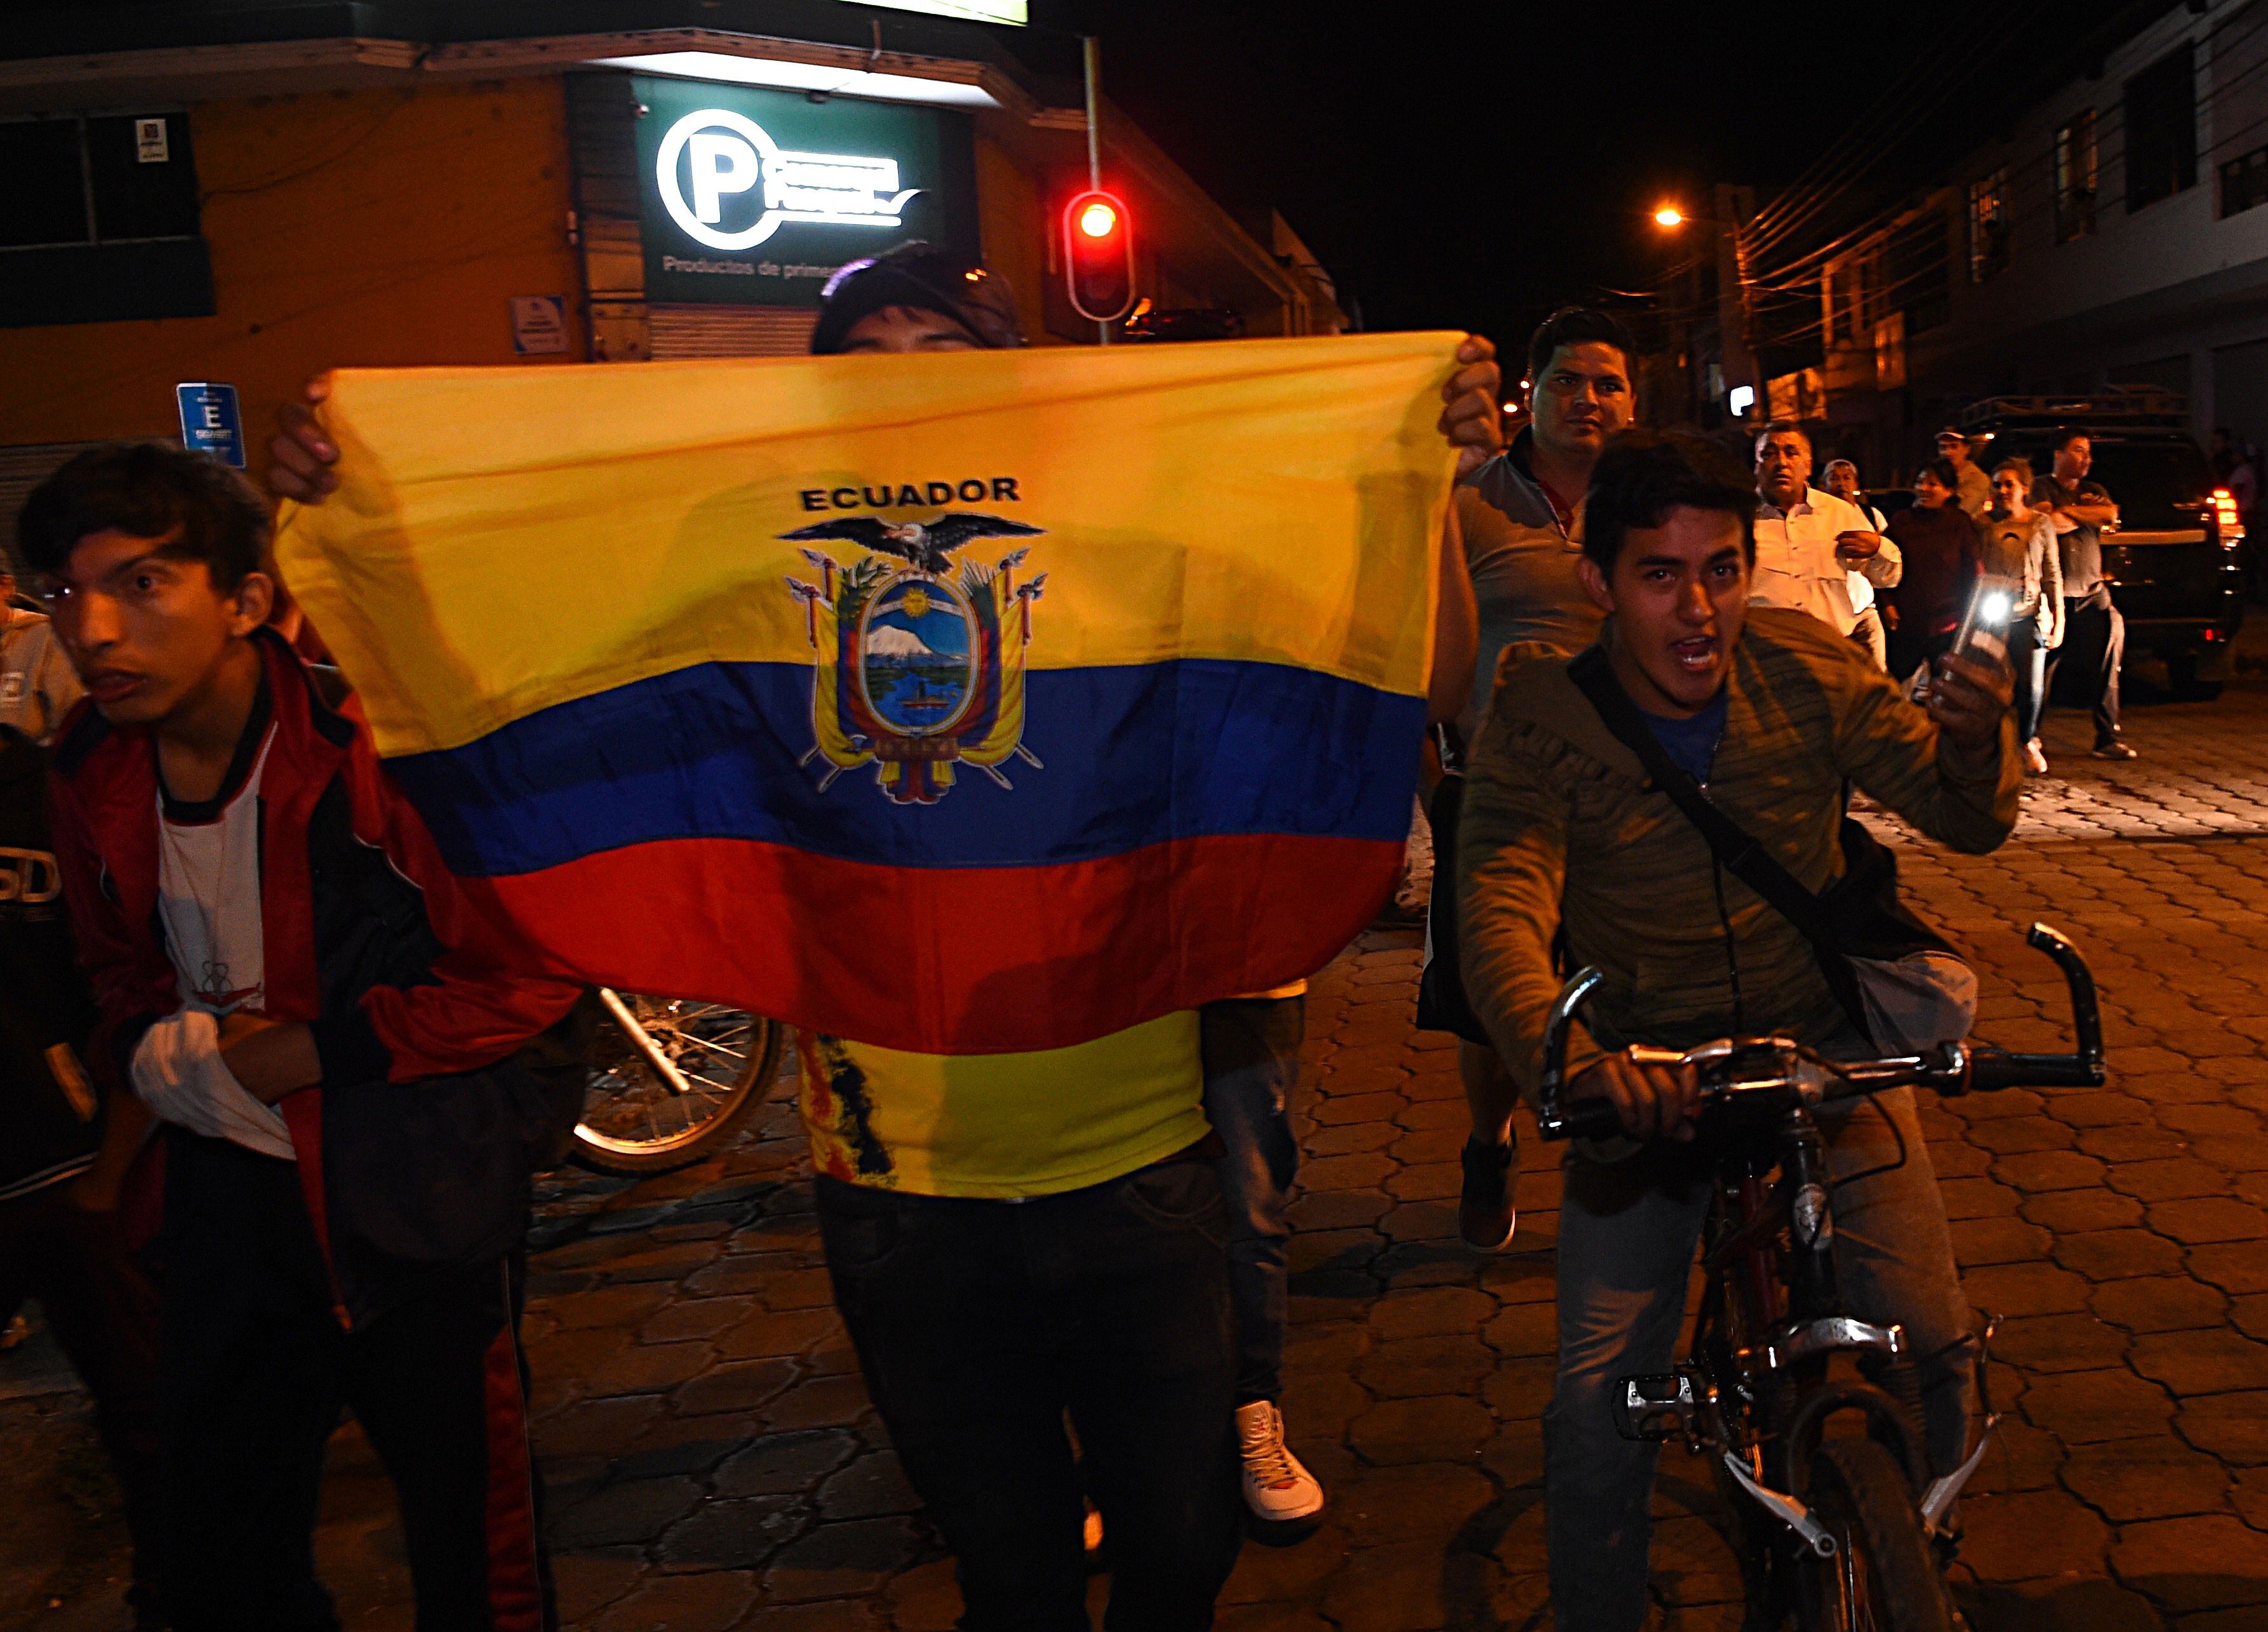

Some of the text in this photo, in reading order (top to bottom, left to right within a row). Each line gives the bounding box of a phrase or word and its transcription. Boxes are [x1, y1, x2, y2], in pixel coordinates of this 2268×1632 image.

[689, 133, 759, 224] P
[757, 261, 780, 276] de
[205, 406, 222, 428] E
[801, 478, 1021, 511] ECUADOR
